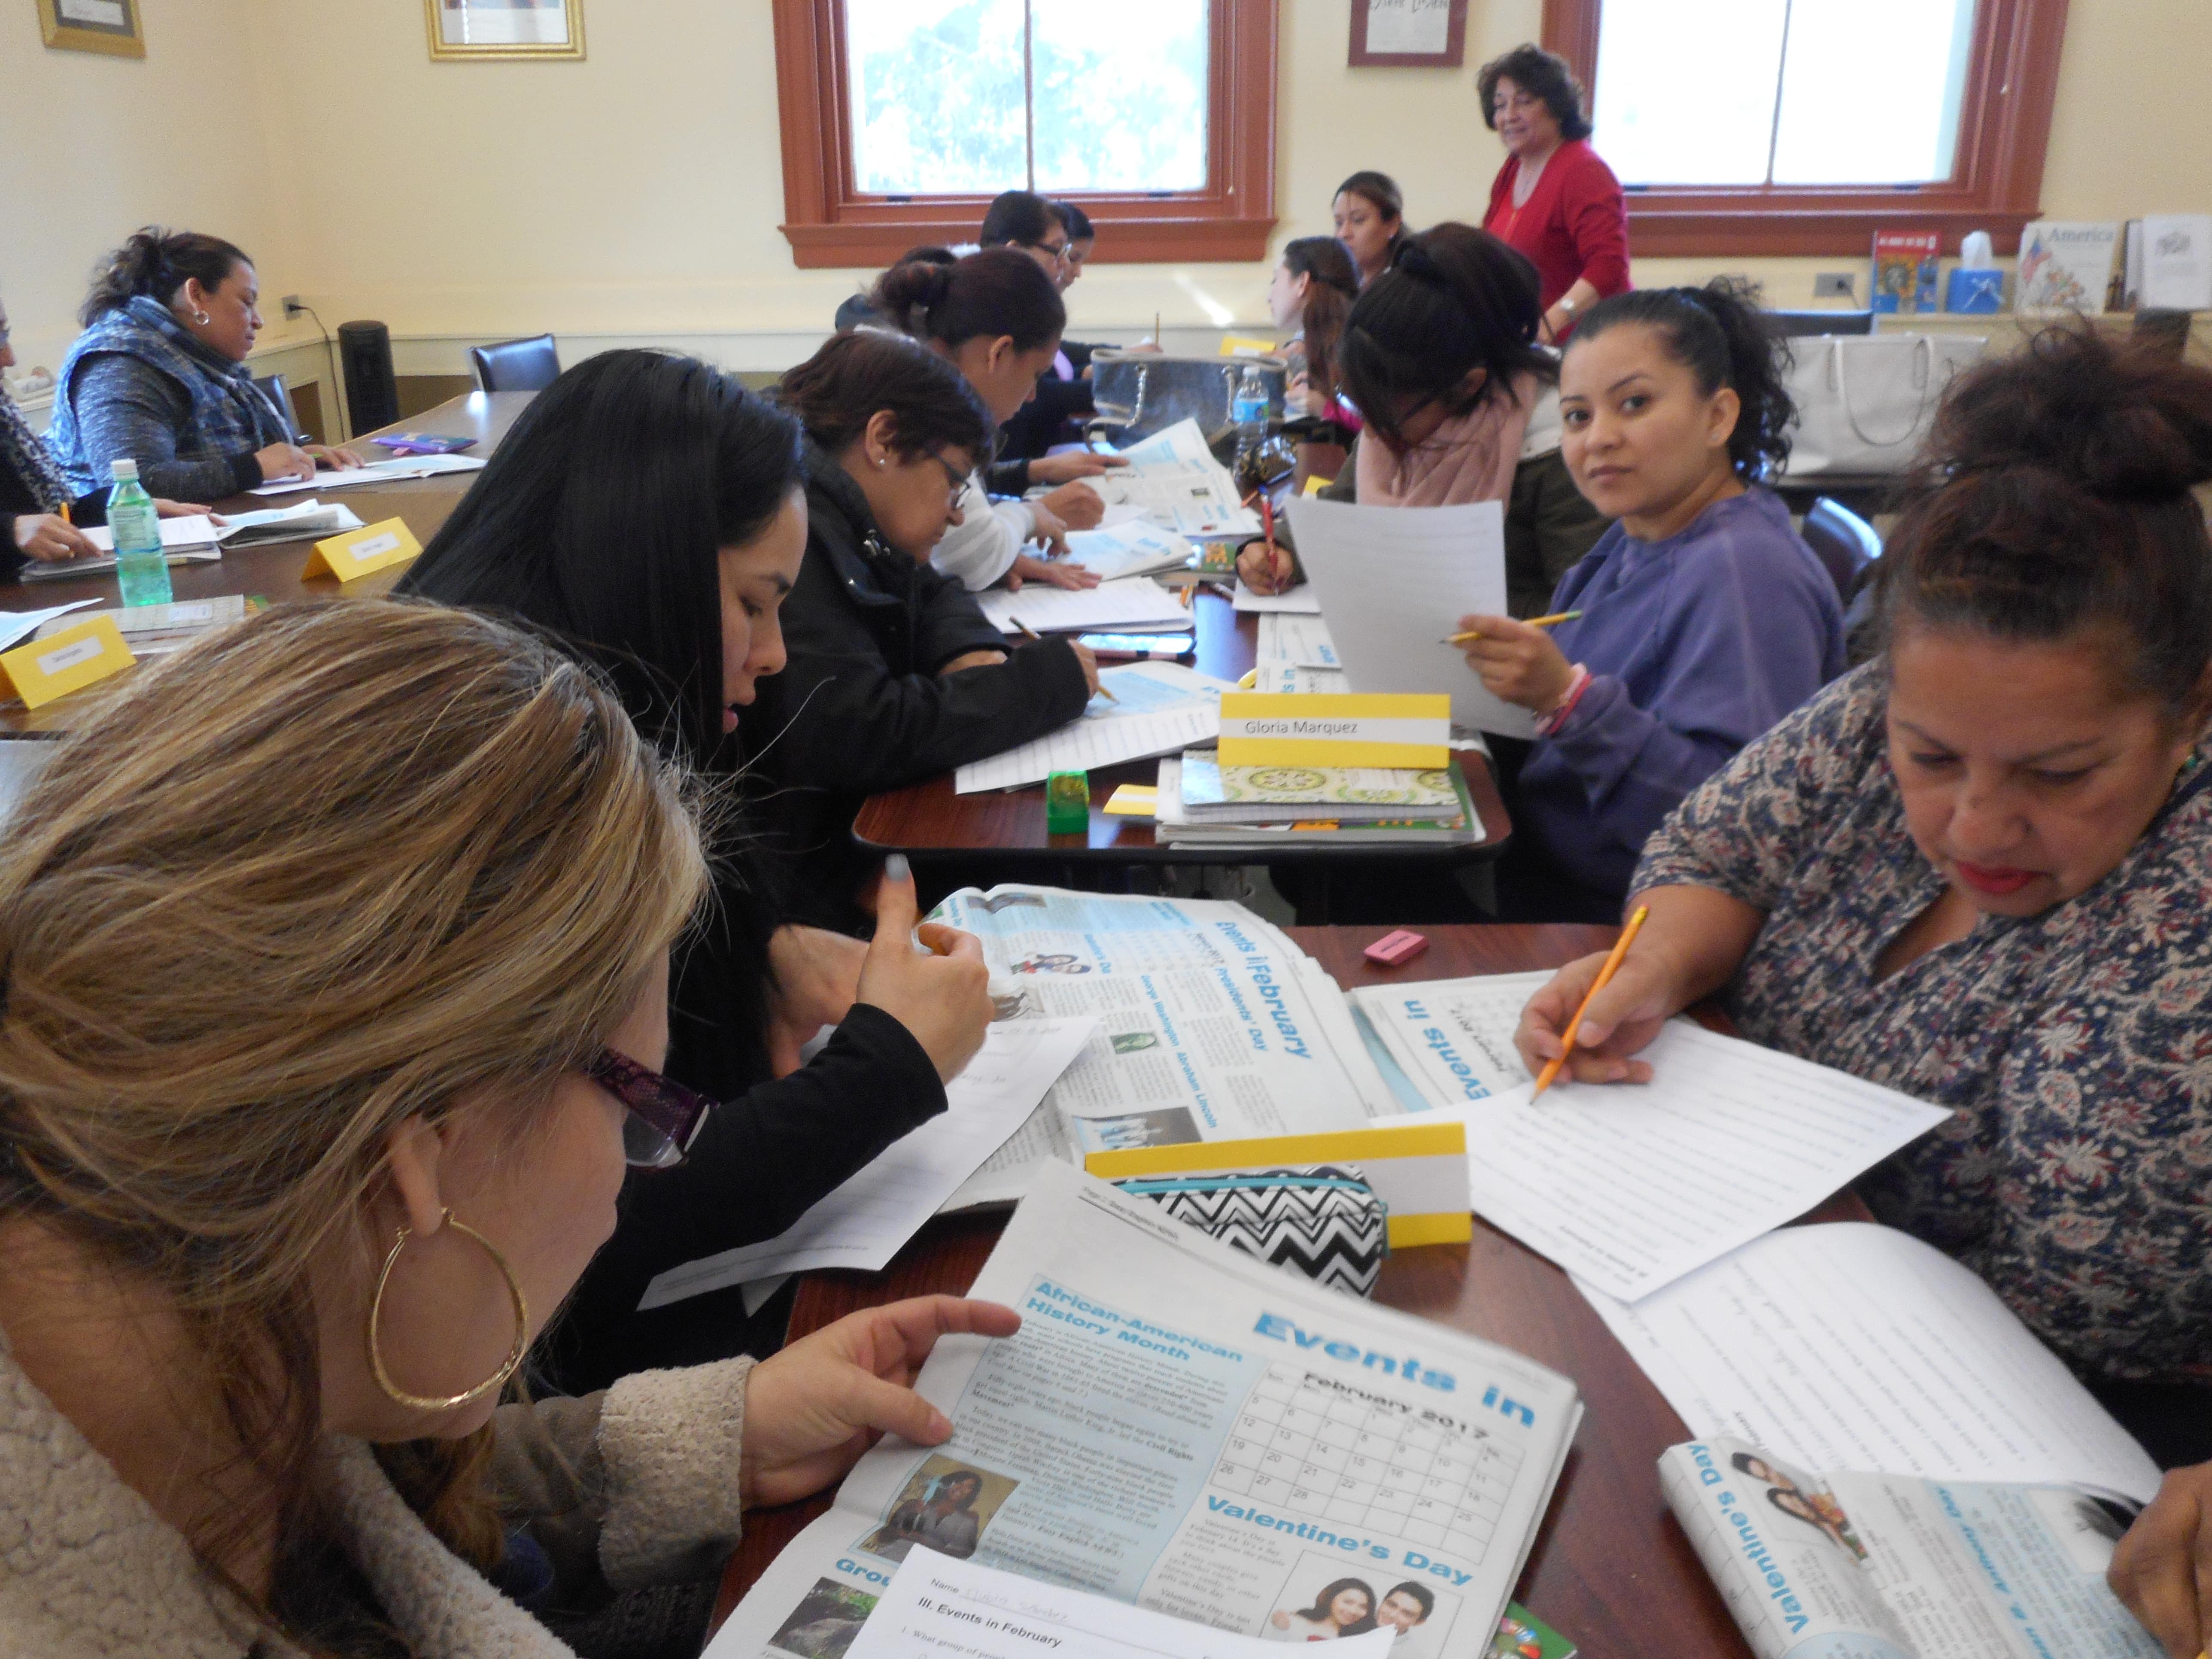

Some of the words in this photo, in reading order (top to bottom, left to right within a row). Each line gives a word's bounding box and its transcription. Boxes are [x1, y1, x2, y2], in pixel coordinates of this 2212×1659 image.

[1245, 720, 1288, 734] Gloria
[1293, 721, 1358, 735] Marquez
[1246, 964, 1312, 1059] February
[1248, 1028, 1267, 1051] Day
[1403, 1000, 1431, 1020] in
[1422, 1027, 1492, 1101] Events
[1026, 1297, 1111, 1335] History
[1117, 1330, 1191, 1361] Month
[1035, 1282, 1243, 1362] African-American
[1253, 1311, 1458, 1392] Events
[1481, 1385, 1536, 1429] in
[1304, 1372, 1412, 1413] February
[1421, 1410, 1489, 1439] 2017
[1687, 1444, 1723, 1486] Day
[1207, 1494, 1391, 1562] Valentine's
[1402, 1550, 1475, 1587] Day
[1717, 1491, 1810, 1635] Valentine's
[930, 1578, 960, 1594] Name
[913, 1630, 936, 1643] What
[937, 1639, 964, 1653] group
[918, 1597, 933, 1610] III.
[936, 1604, 983, 1624] Events
[986, 1617, 999, 1629] in
[1002, 1622, 1062, 1648] February
